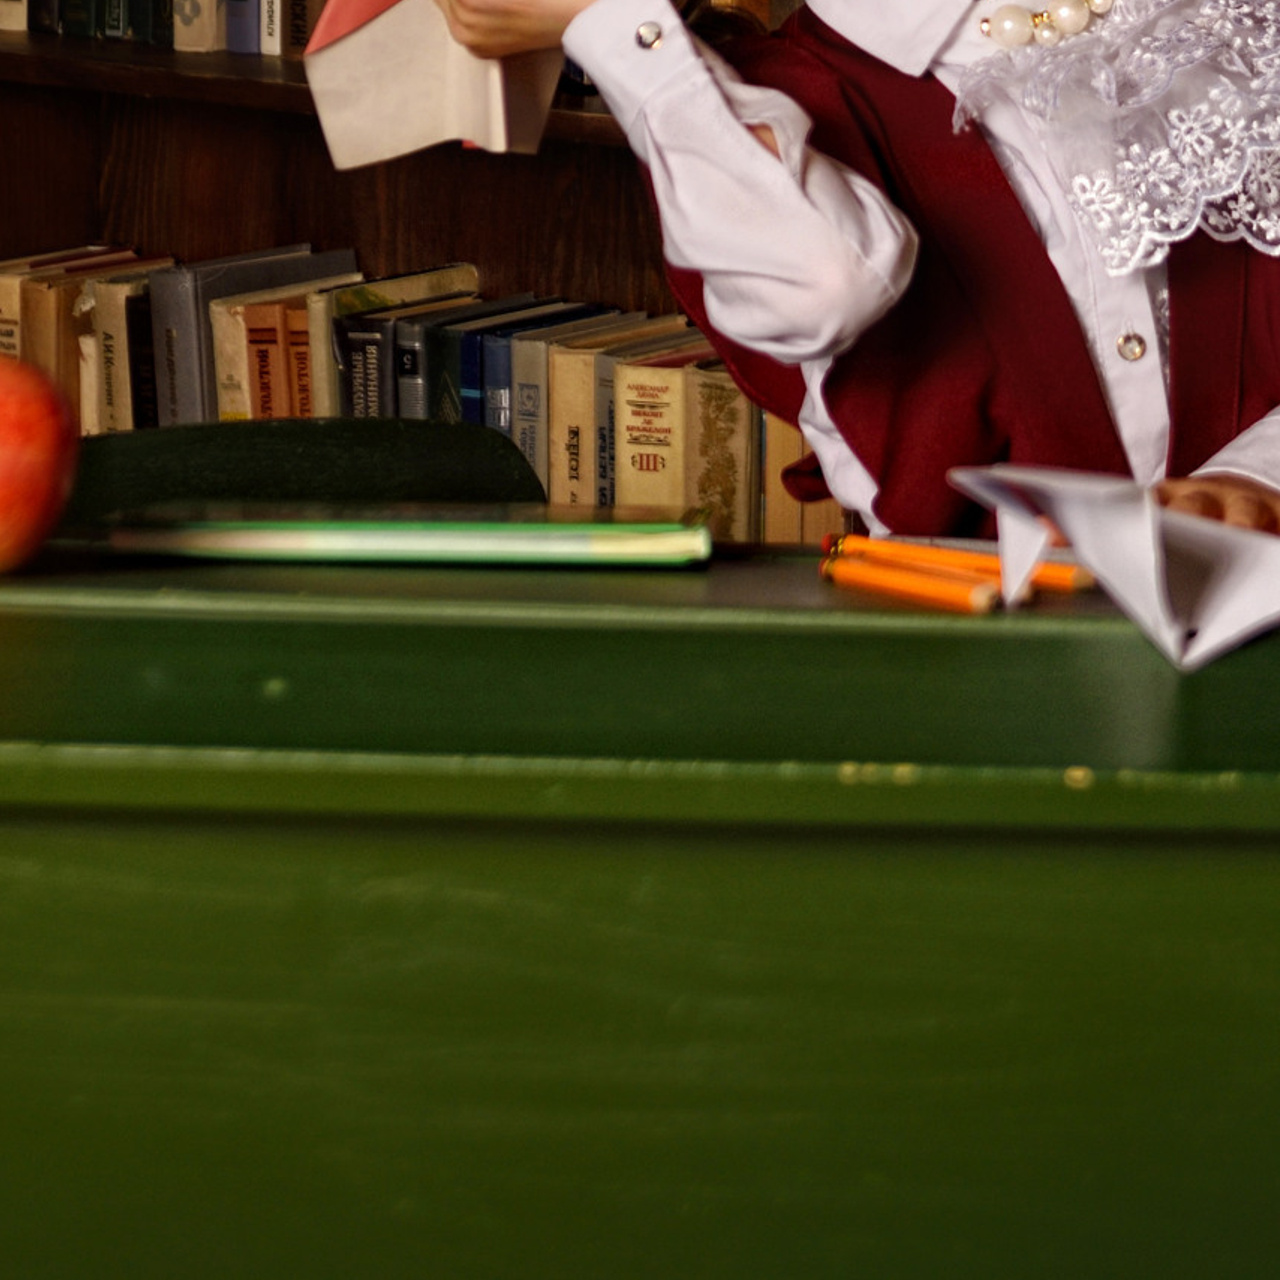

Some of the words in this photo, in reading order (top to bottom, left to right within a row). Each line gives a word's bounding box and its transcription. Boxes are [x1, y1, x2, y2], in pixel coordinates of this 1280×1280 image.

[352, 352, 366, 417] РАТУРНЫЕ
[365, 345, 379, 417] ОМИНАНИЯ
[626, 383, 669, 393] АЛЕКСАНДР
[631, 409, 663, 418] ВИКОНТ
[626, 425, 672, 434] БРАЖЕЛОН
[638, 453, 659, 471] III
